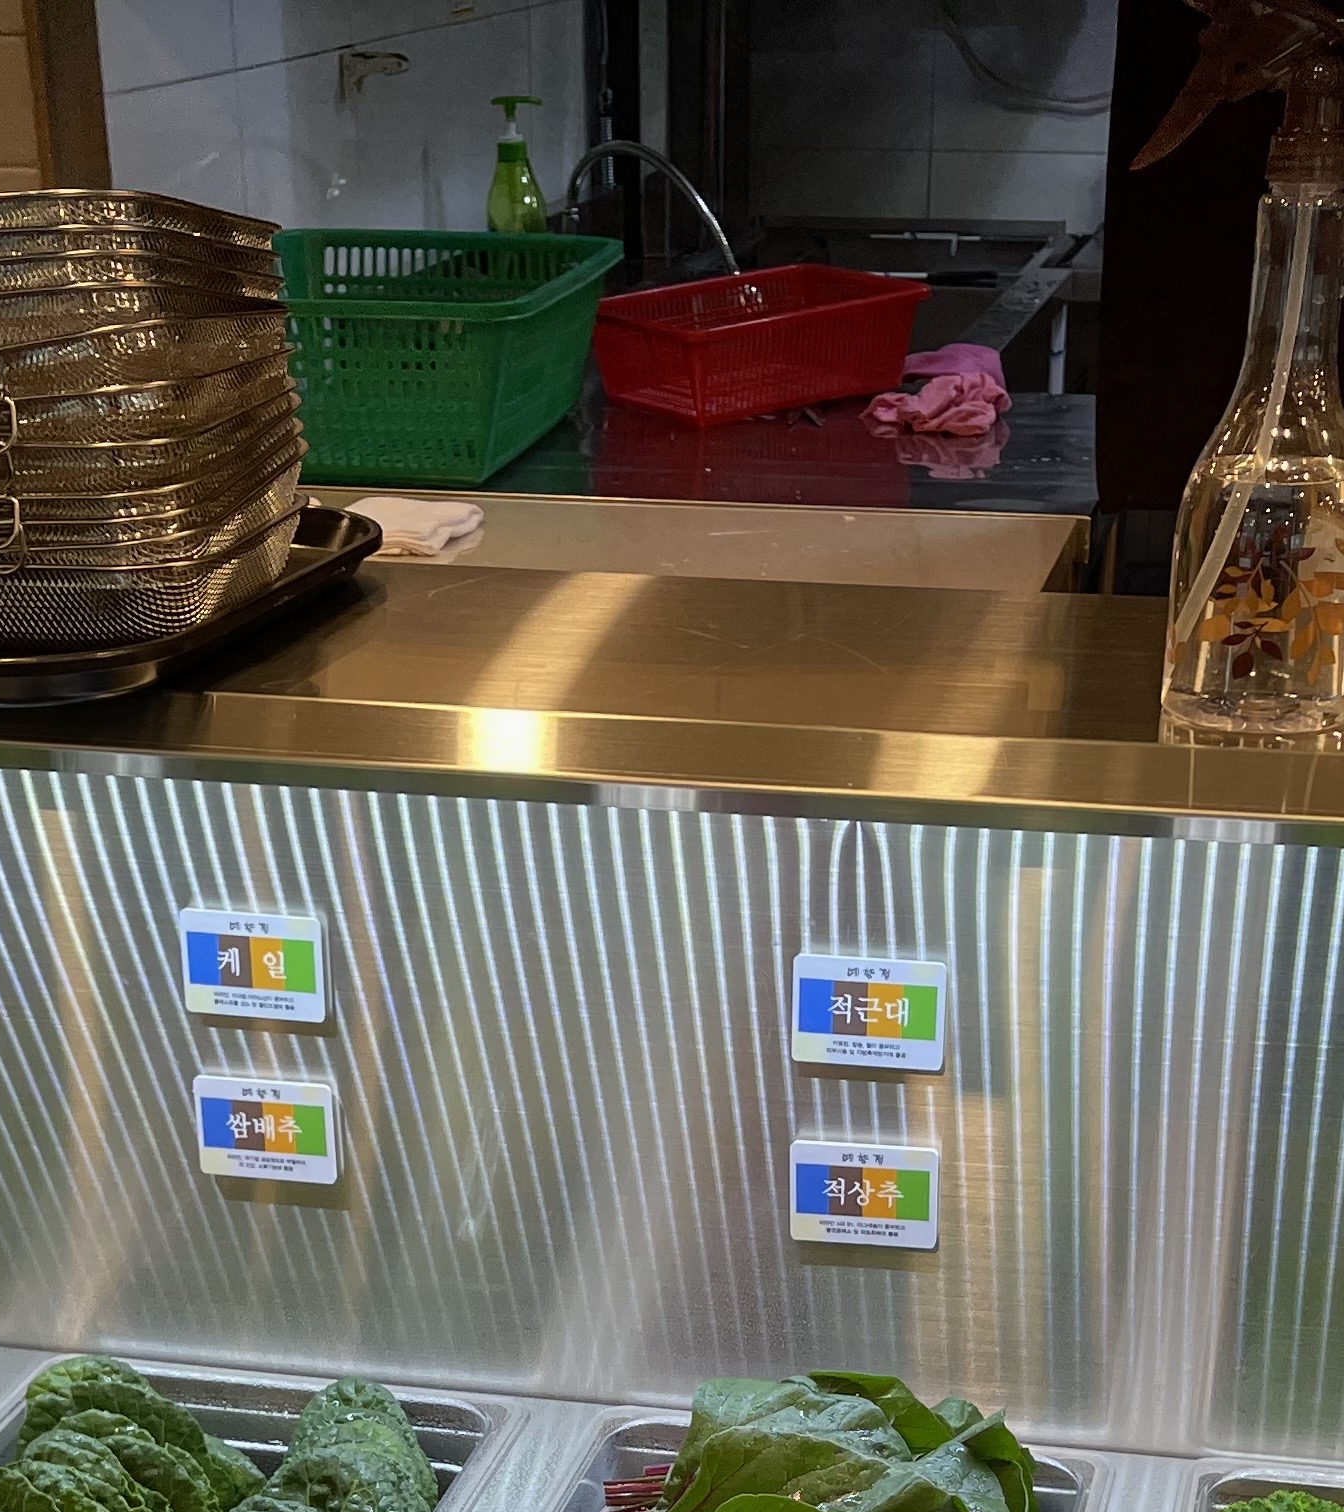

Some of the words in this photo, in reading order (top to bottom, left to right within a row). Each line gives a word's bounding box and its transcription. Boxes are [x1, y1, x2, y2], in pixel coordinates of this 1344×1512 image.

[217, 946, 288, 981] 케일
[827, 993, 911, 1028] 적근대
[225, 1111, 303, 1145] 쌈배추
[821, 1177, 905, 1209] 적상추
